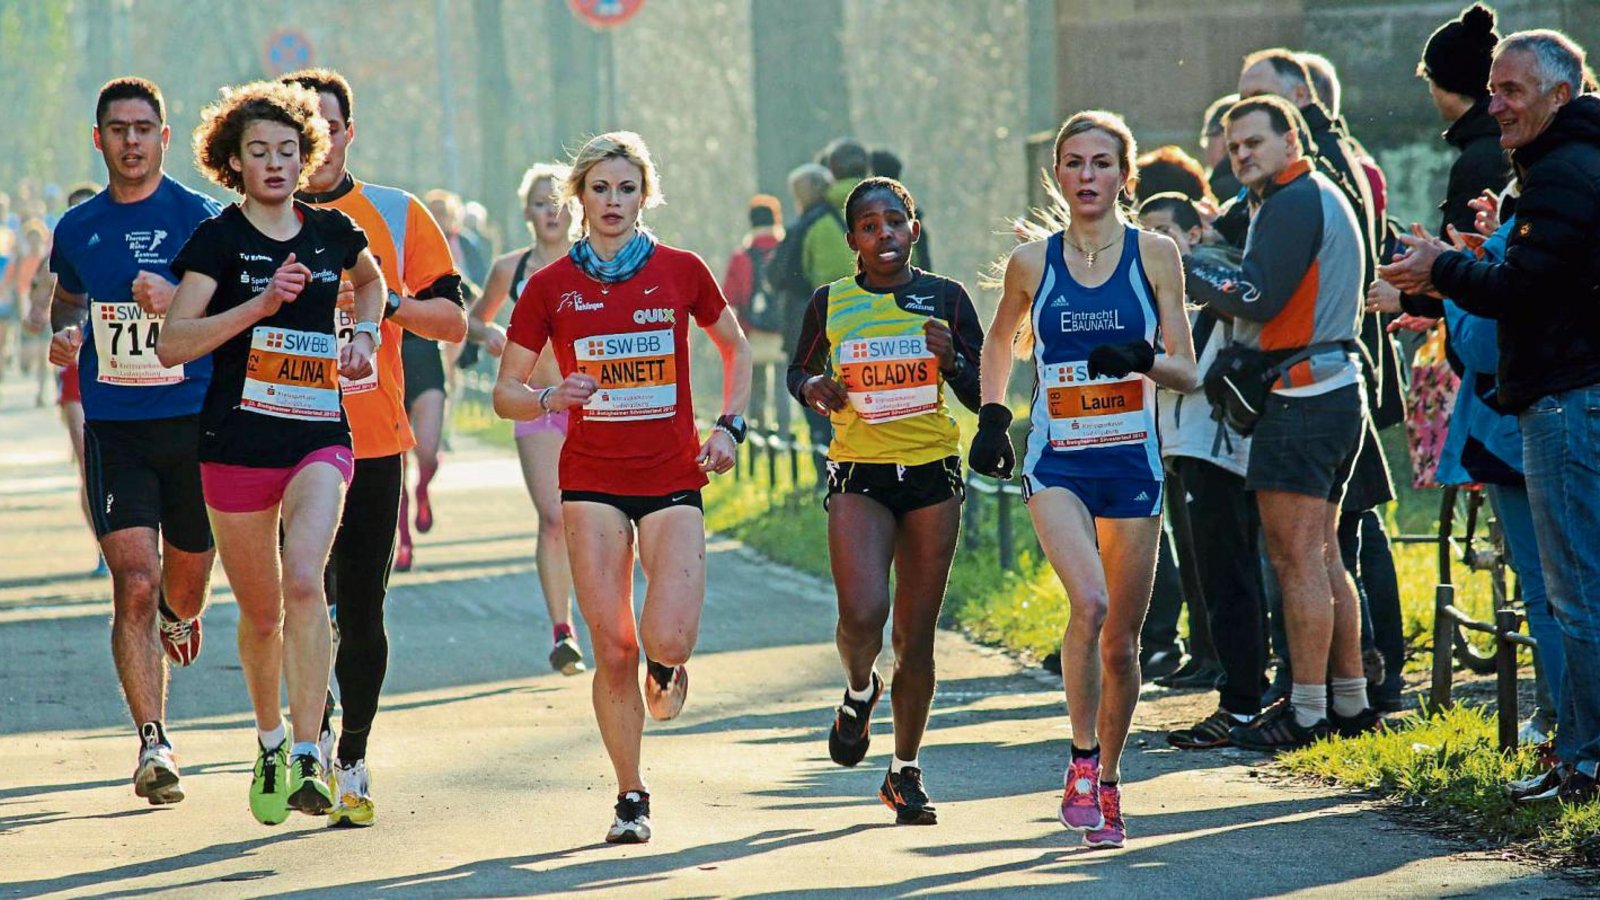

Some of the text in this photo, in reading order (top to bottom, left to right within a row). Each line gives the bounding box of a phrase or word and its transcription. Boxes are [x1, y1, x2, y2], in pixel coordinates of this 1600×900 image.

[251, 276, 270, 284] Spark
[633, 308, 675, 324] QUIX
[109, 322, 160, 356] 714
[278, 357, 325, 384] ALINA
[601, 359, 665, 384] ANNETT
[861, 361, 928, 387] GLADYS
[1050, 391, 1061, 416] F18
[1081, 394, 1125, 411] Laura
